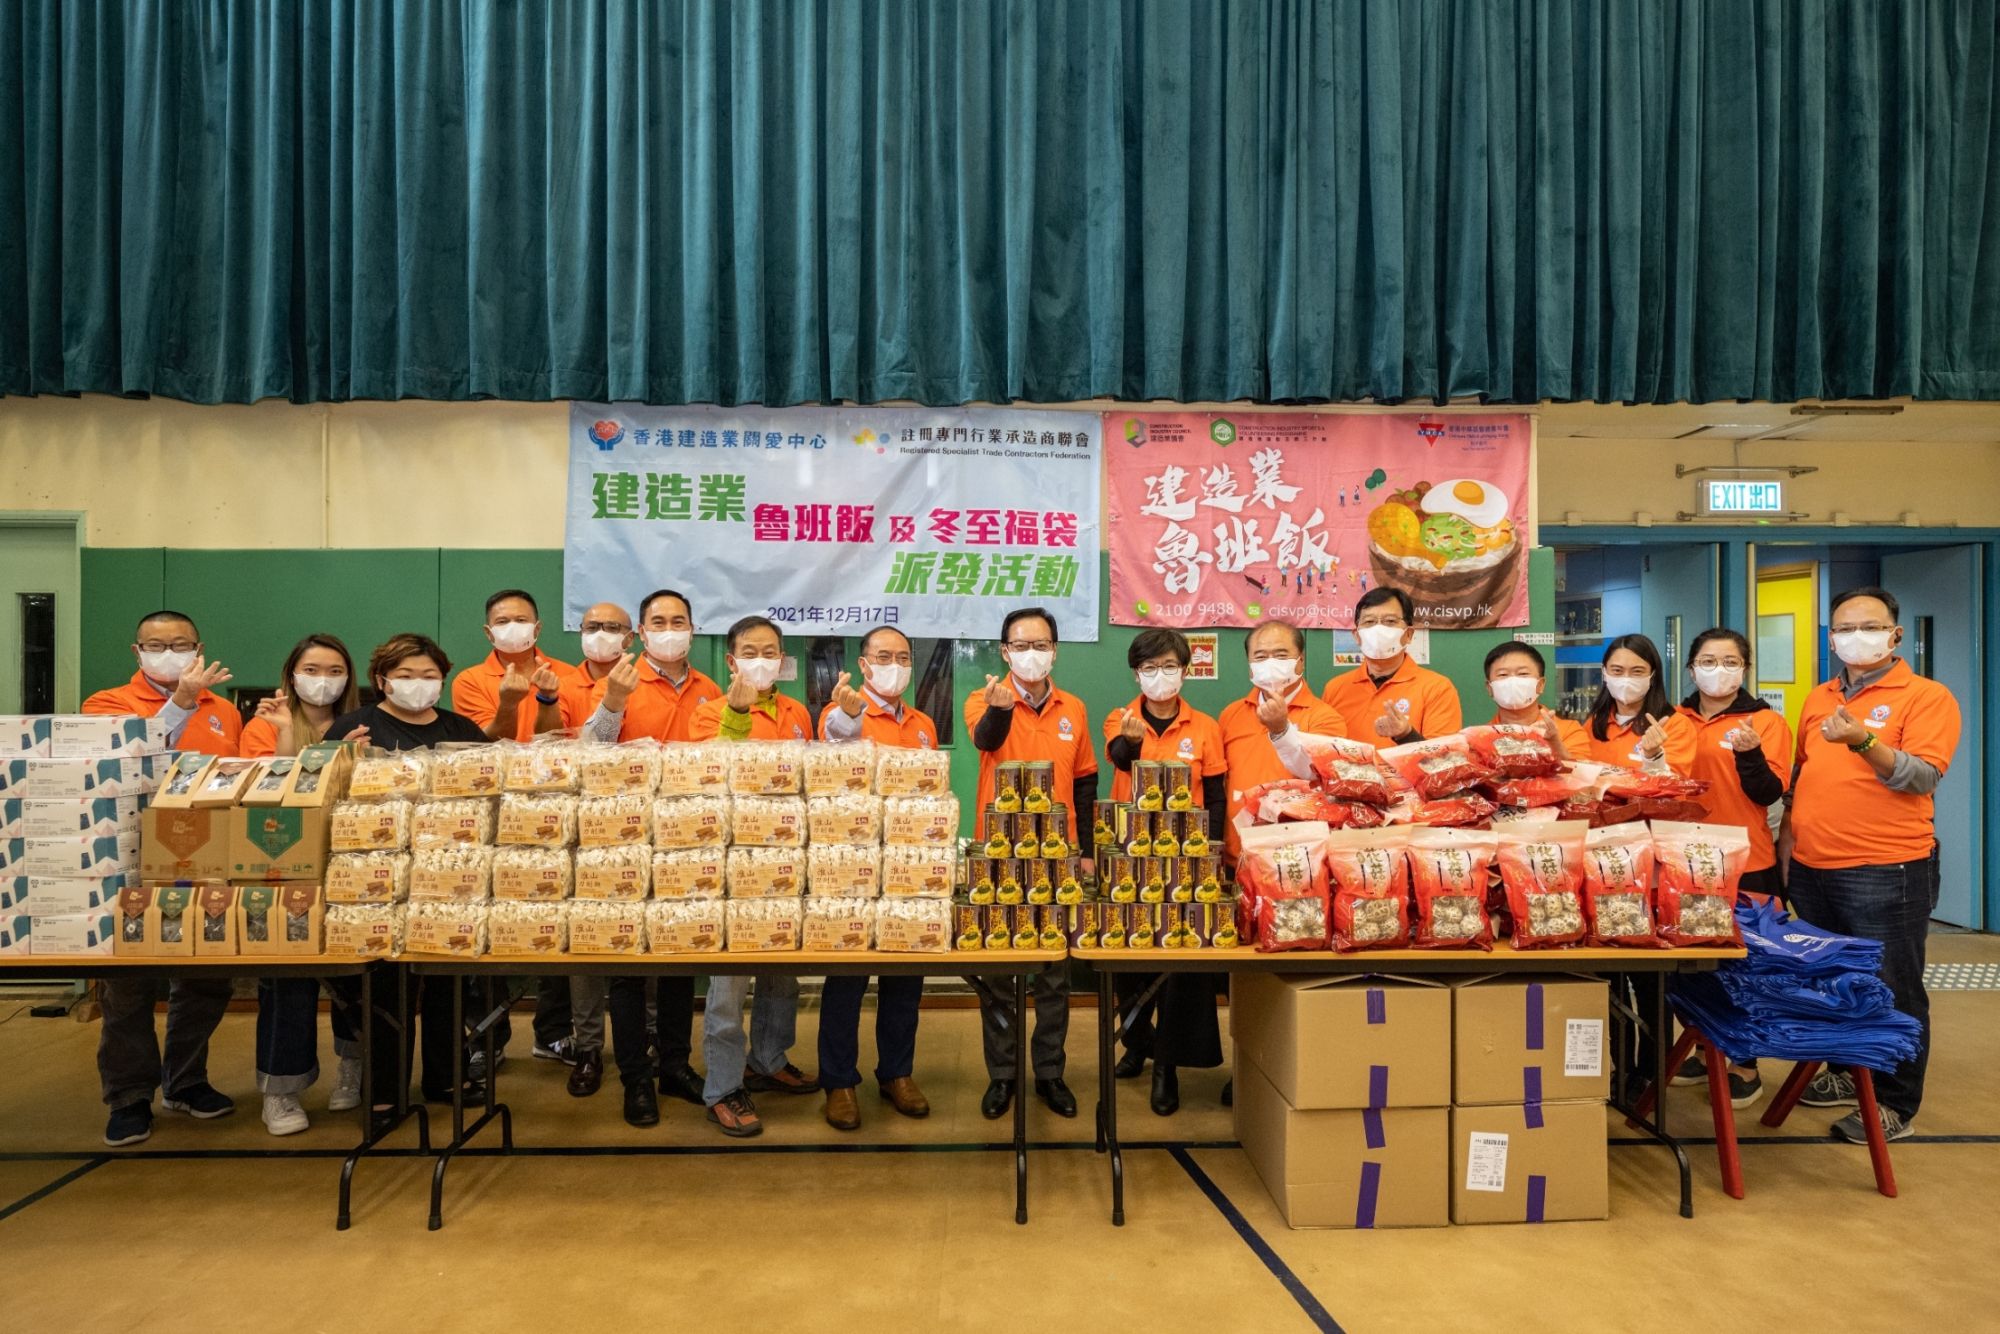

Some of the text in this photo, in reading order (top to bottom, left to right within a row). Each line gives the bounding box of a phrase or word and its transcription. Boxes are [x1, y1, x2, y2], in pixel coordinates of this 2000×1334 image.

[633, 428, 827, 449] 香港建造業關愛中心
[901, 427, 1090, 447] 註冊專門行業承造商聯會
[942, 448, 979, 456] Specialist
[982, 448, 1003, 456] Trade
[1004, 450, 1049, 458] Contractors
[1051, 451, 1091, 460] Federation
[1140, 447, 1304, 522] 建造業
[592, 472, 746, 522] 建造業
[1712, 484, 1778, 509] EXIT 出口
[753, 503, 1078, 547] 魯班飯 及 冬至福袋
[1151, 507, 1340, 595] 魯班飯
[884, 551, 1080, 598] 派發活動
[767, 606, 899, 624] 2021年12月17日
[1155, 602, 1235, 617] 2100 9488
[1268, 604, 1357, 619] cisvp@cic.h
[1413, 603, 1493, 619] w.cisvp.hk
